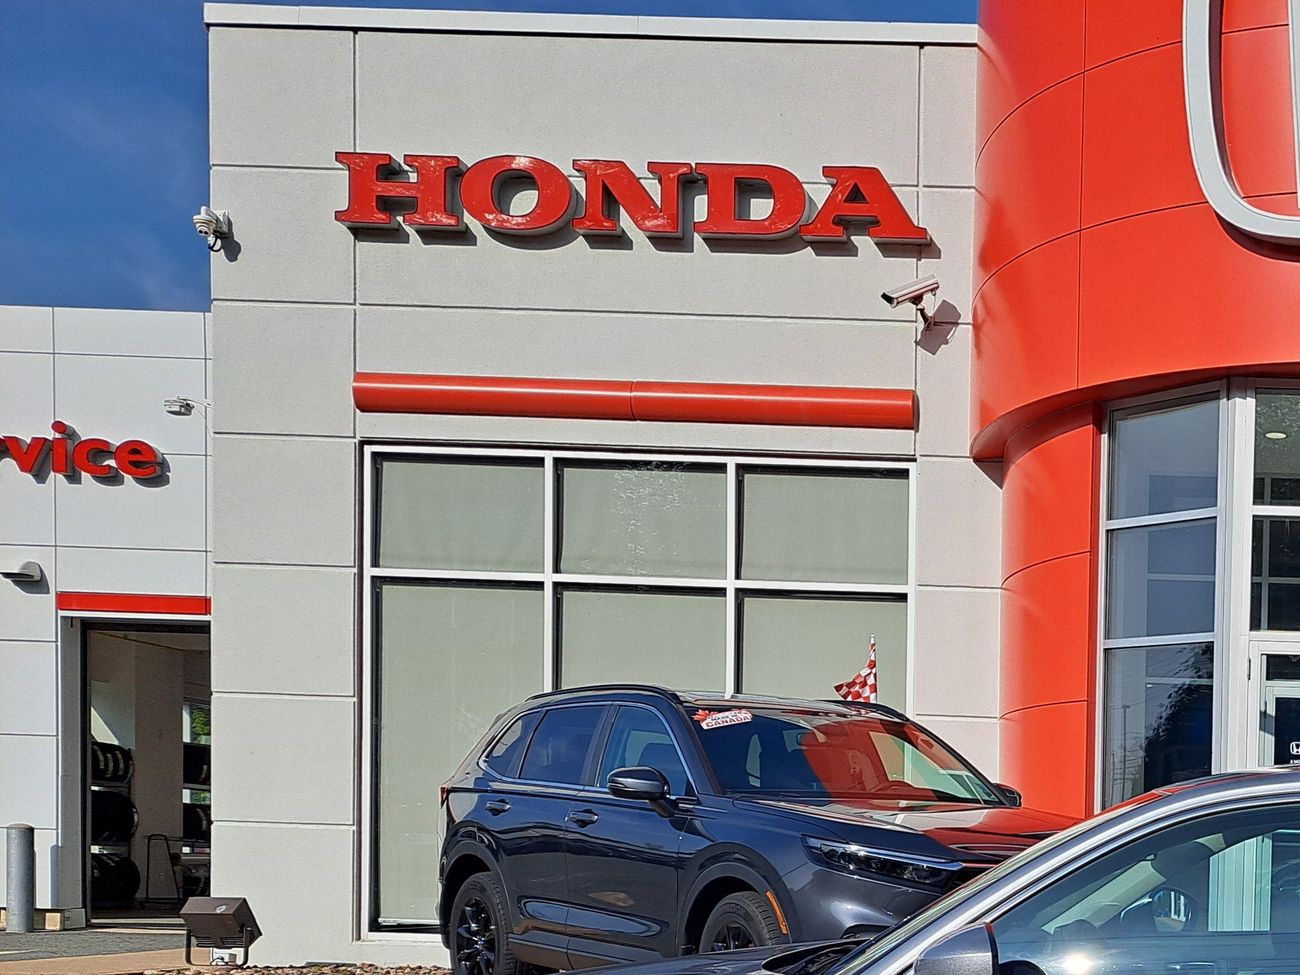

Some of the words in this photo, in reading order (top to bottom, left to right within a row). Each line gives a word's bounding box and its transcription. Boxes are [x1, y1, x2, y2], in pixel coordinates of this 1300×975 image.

[334, 150, 930, 243] HONDA
[0, 420, 159, 478] vice
[705, 715, 750, 727] CANADA
